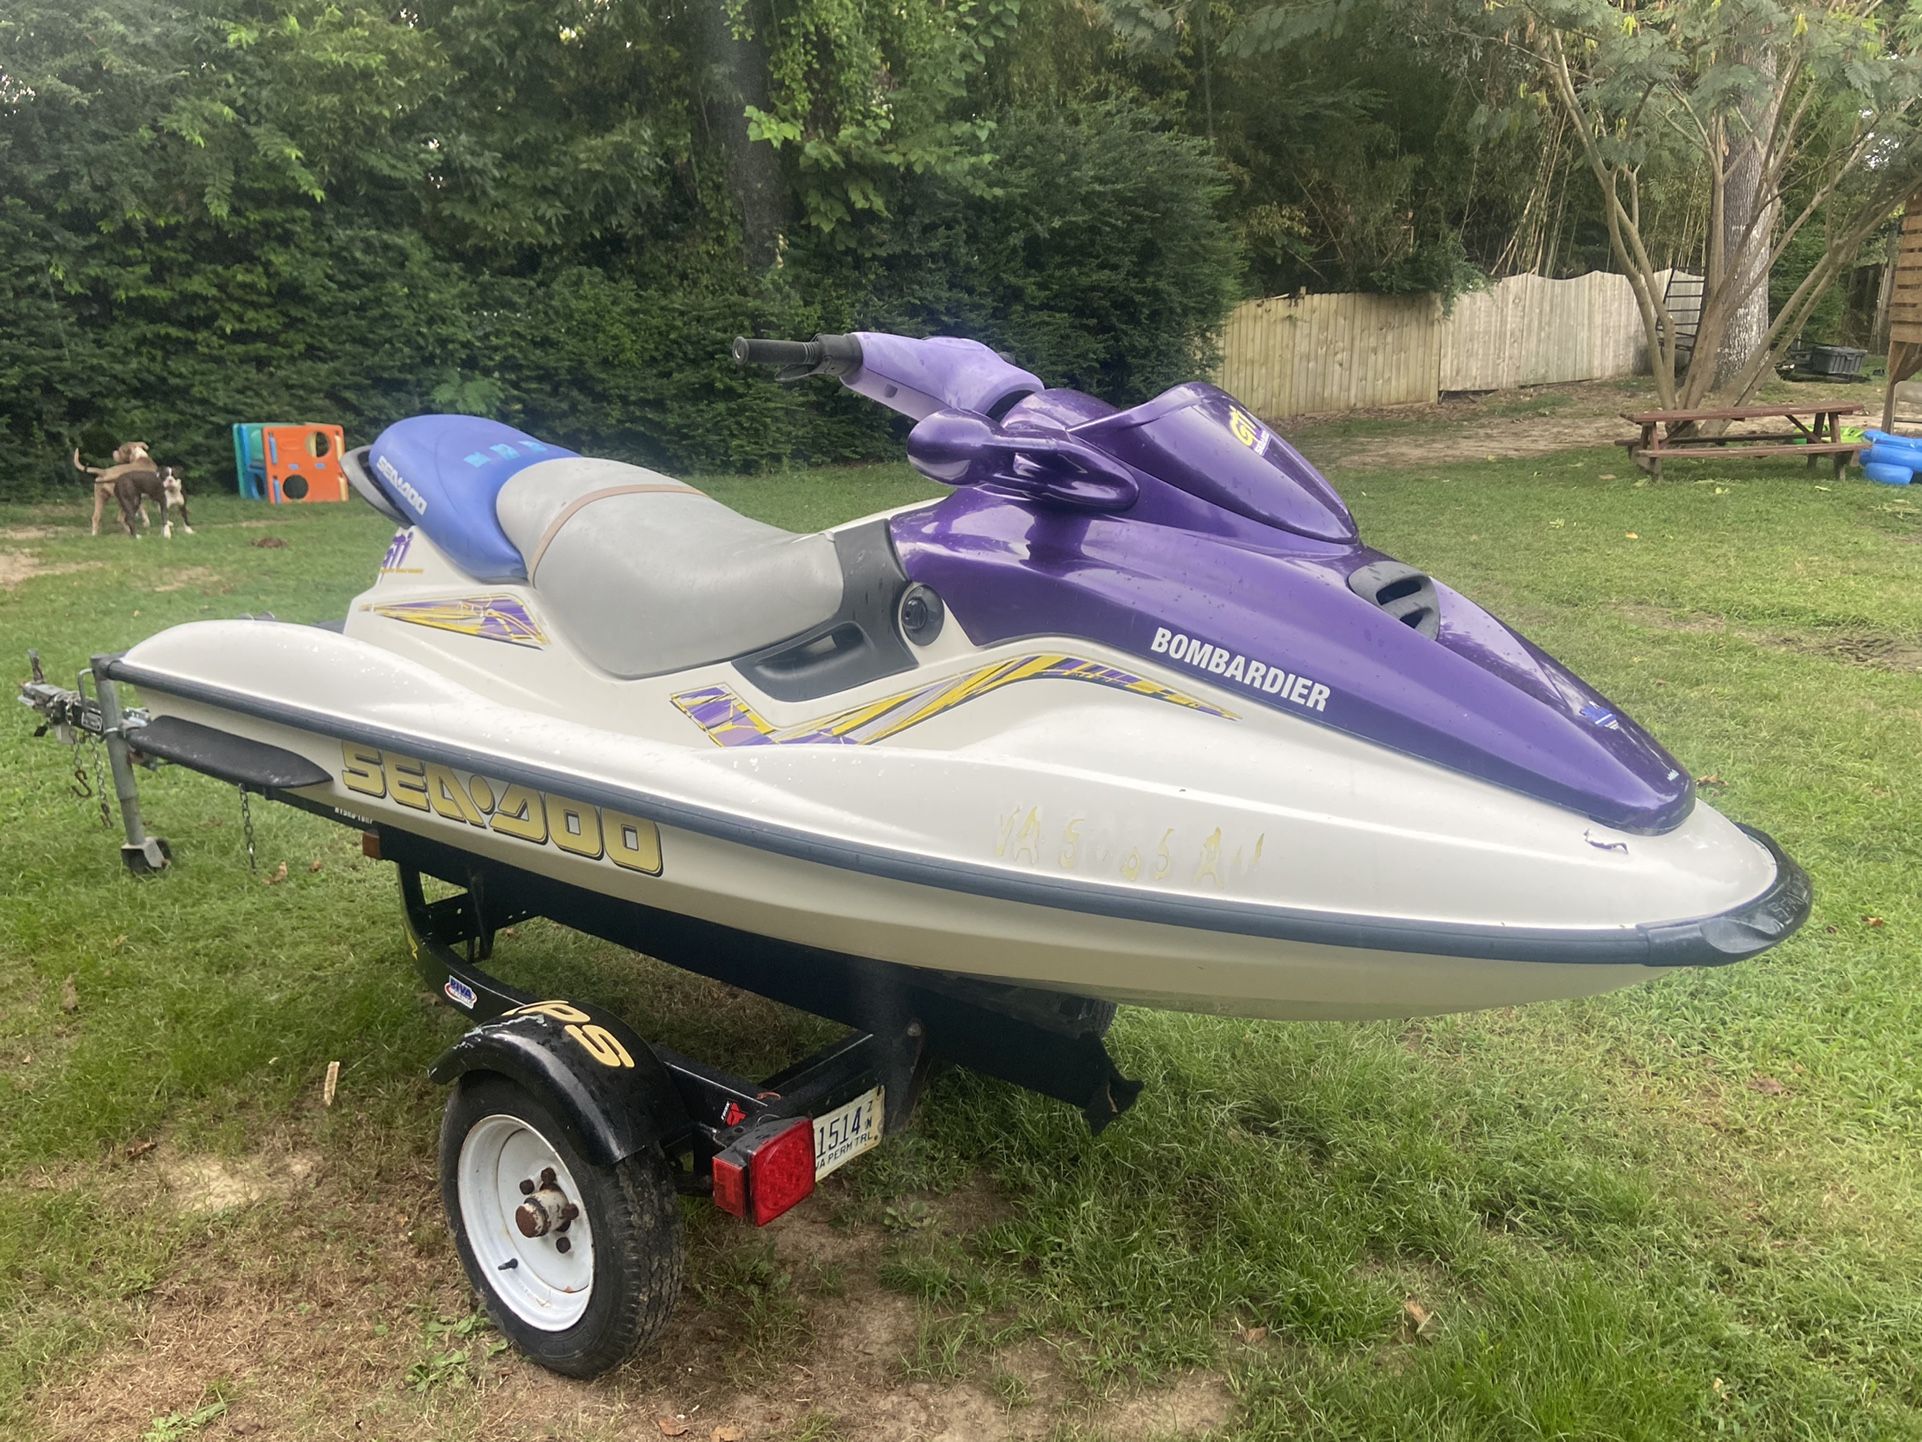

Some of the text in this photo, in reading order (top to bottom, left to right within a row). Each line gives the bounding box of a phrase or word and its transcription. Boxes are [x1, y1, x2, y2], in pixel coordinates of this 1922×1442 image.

[1150, 626, 1331, 712] BOMBARDIER
[816, 1105, 862, 1158] 1514
[827, 1141, 853, 1165] PERM
[854, 1131, 874, 1147] TRL
